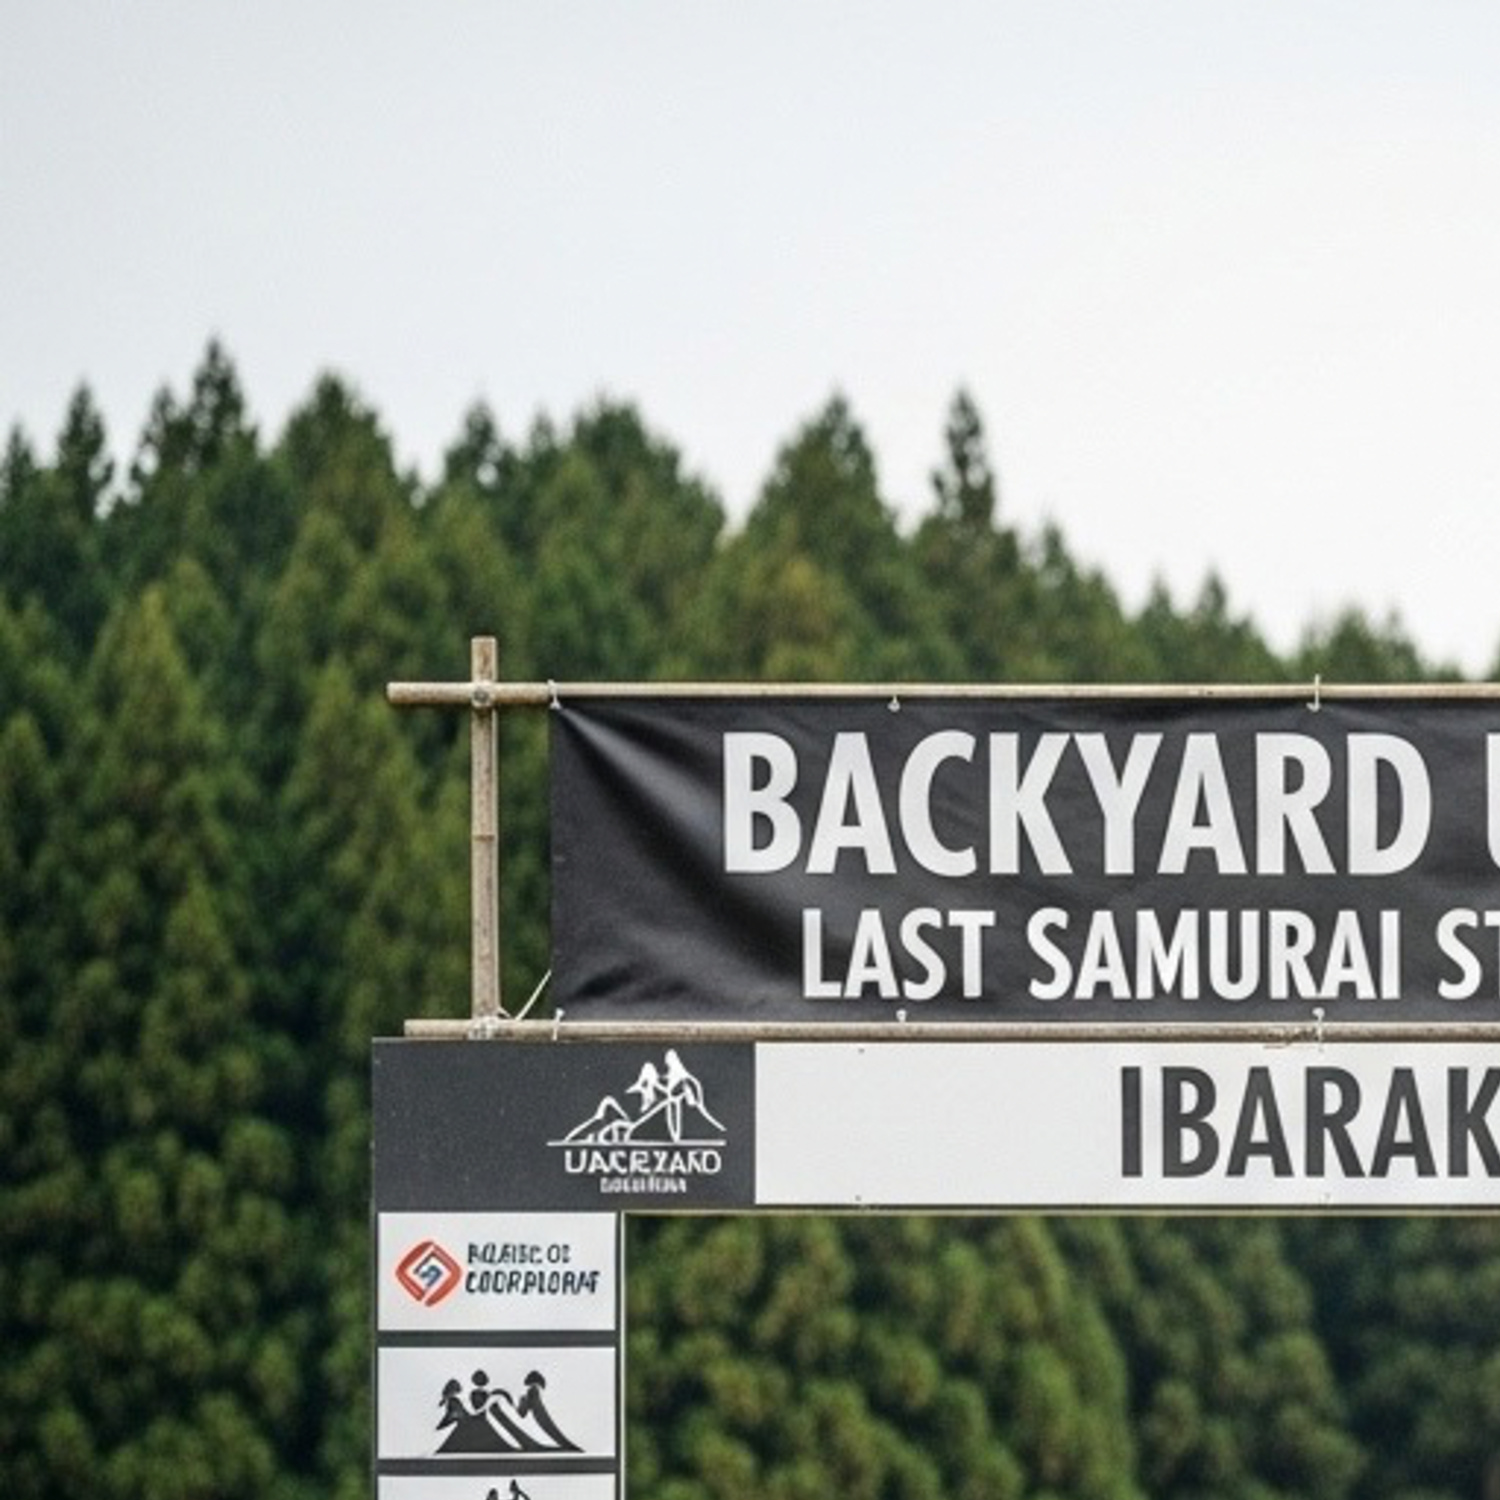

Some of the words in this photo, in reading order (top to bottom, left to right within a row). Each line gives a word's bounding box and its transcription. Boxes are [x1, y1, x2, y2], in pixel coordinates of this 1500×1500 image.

[724, 731, 1431, 879] BACKYARD
[803, 908, 995, 1001] LAST
[1028, 908, 1399, 1003] SAMURAI
